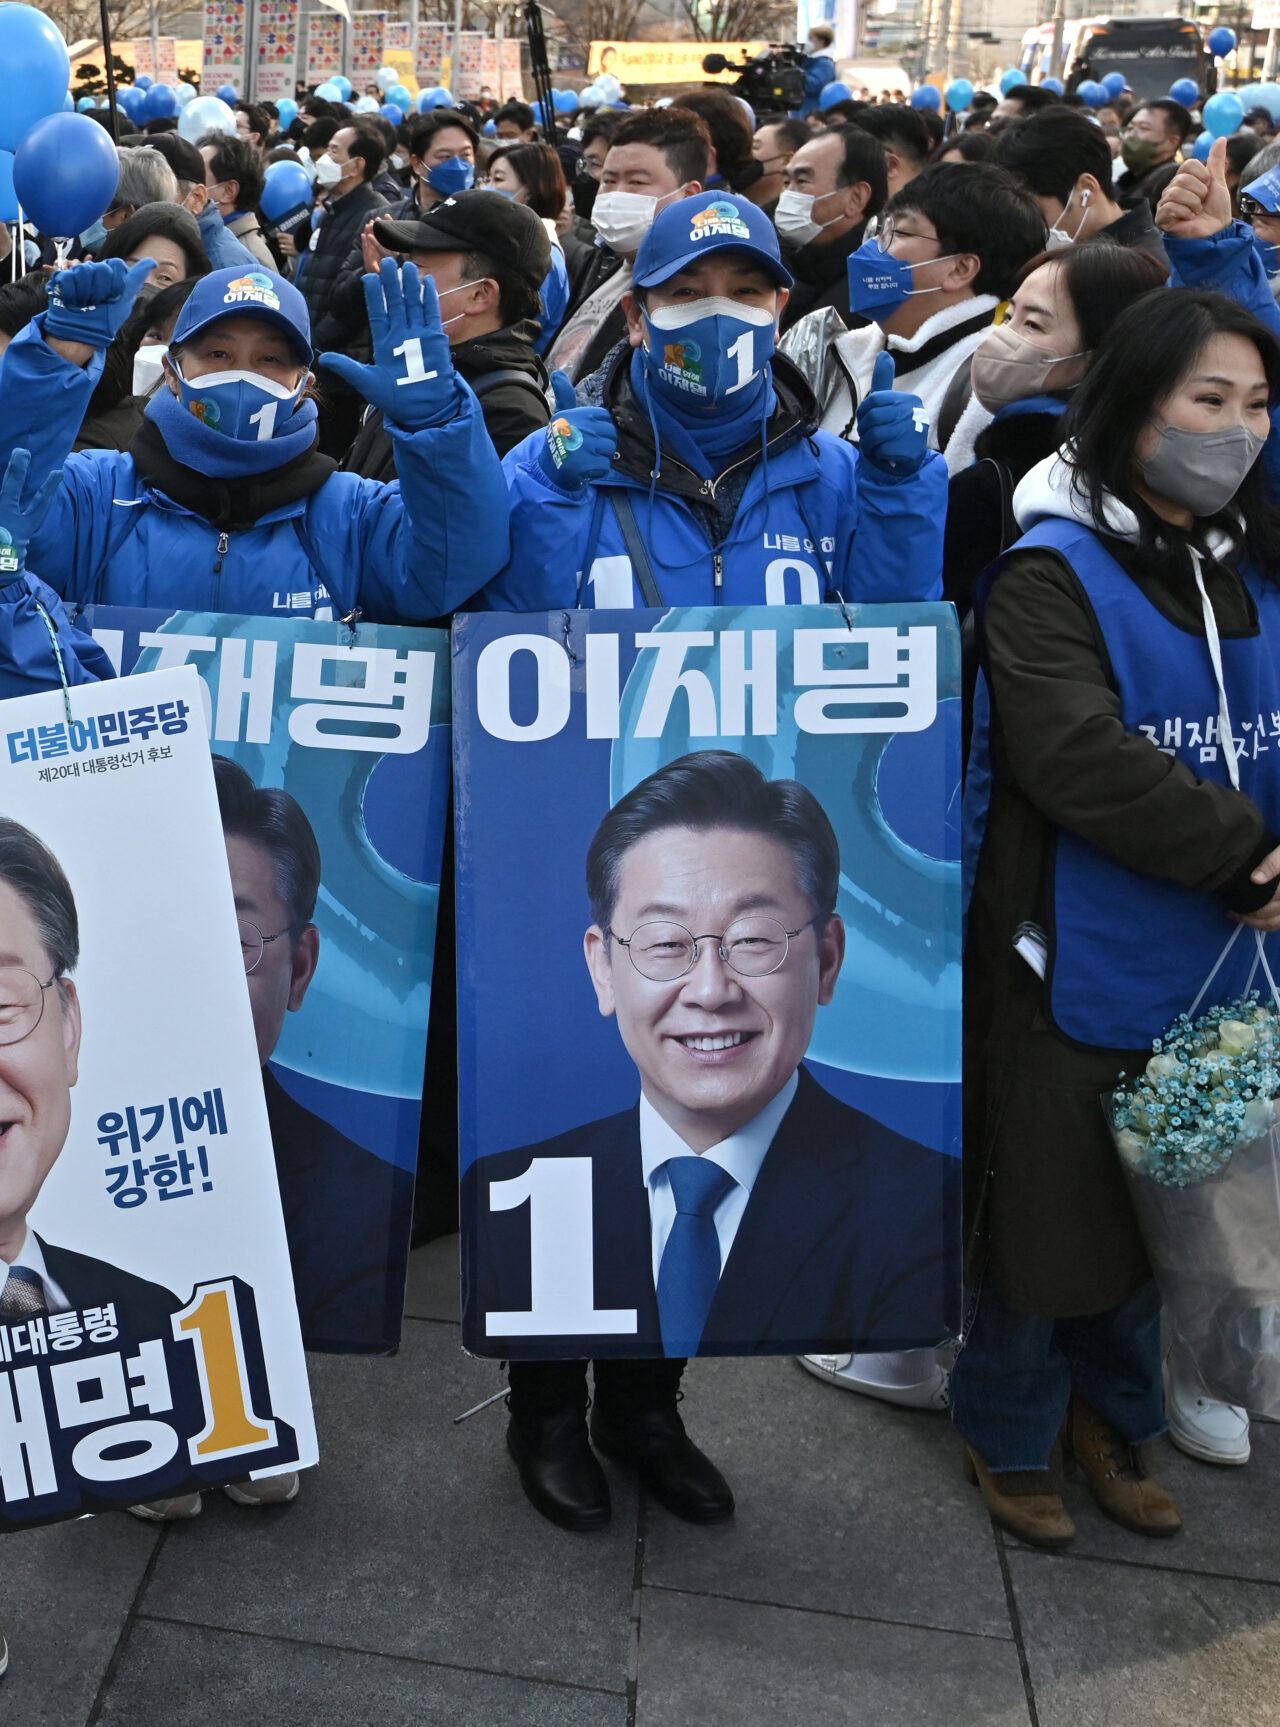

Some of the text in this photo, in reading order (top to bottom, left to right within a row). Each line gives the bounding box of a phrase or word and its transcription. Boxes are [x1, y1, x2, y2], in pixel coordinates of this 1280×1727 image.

[690, 223, 751, 242] 이재명
[392, 338, 438, 386] 1
[658, 368, 707, 397] 이재명
[725, 330, 760, 396] 1
[249, 401, 278, 441] 1
[763, 533, 802, 551] 나를
[273, 592, 312, 609] 나를
[476, 626, 938, 742] 이재명
[6, 700, 190, 764] 더불어민주당
[38, 745, 173, 783] 제20대 대통령선거 후보
[95, 1088, 229, 1160] 위기에
[102, 1145, 216, 1211] 강한!
[485, 1157, 638, 1338] 1
[173, 1277, 277, 1466] 1
